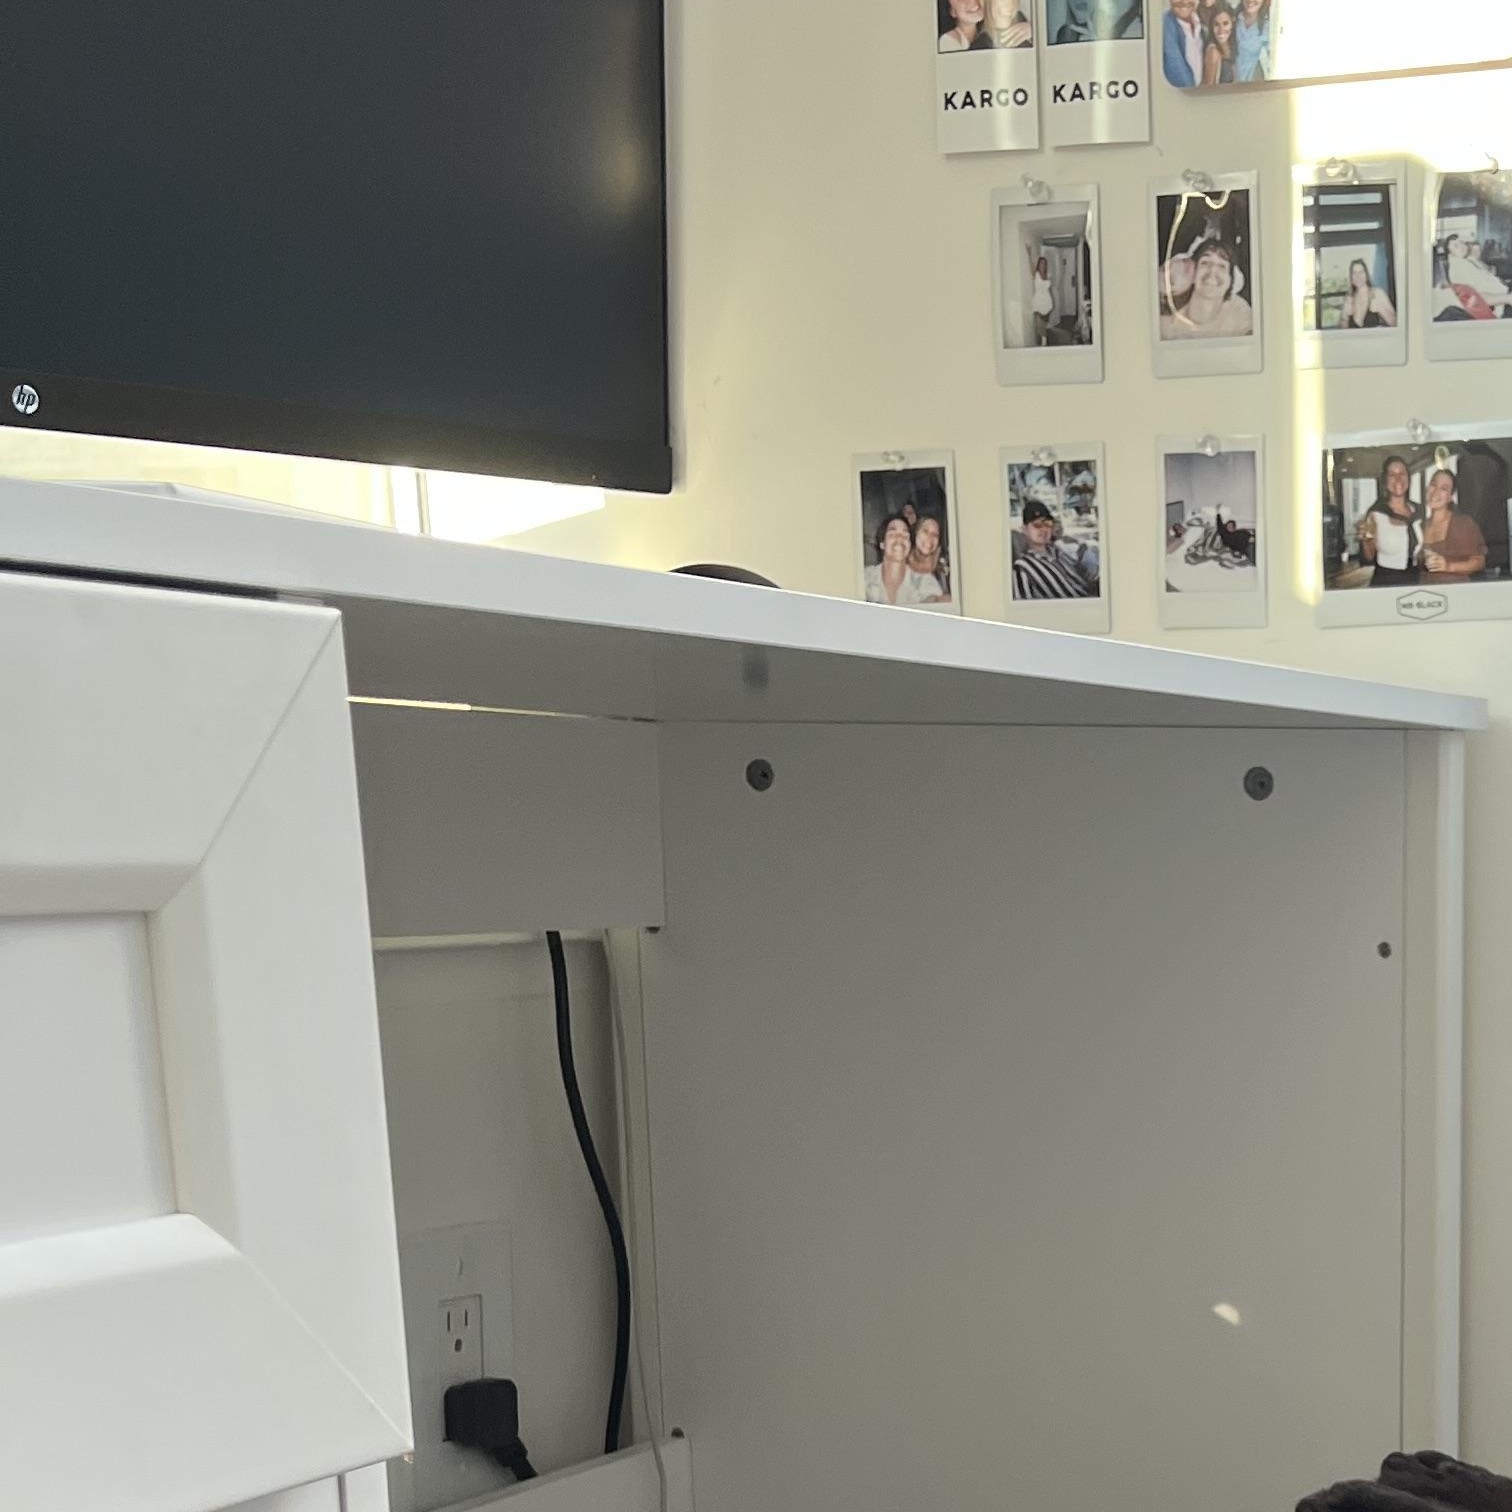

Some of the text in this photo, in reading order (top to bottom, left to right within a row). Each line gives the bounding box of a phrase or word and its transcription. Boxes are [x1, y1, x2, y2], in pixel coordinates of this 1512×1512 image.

[943, 88, 1028, 111] KARGO
[1052, 80, 1138, 103] KARGO
[15, 385, 36, 413] hp
